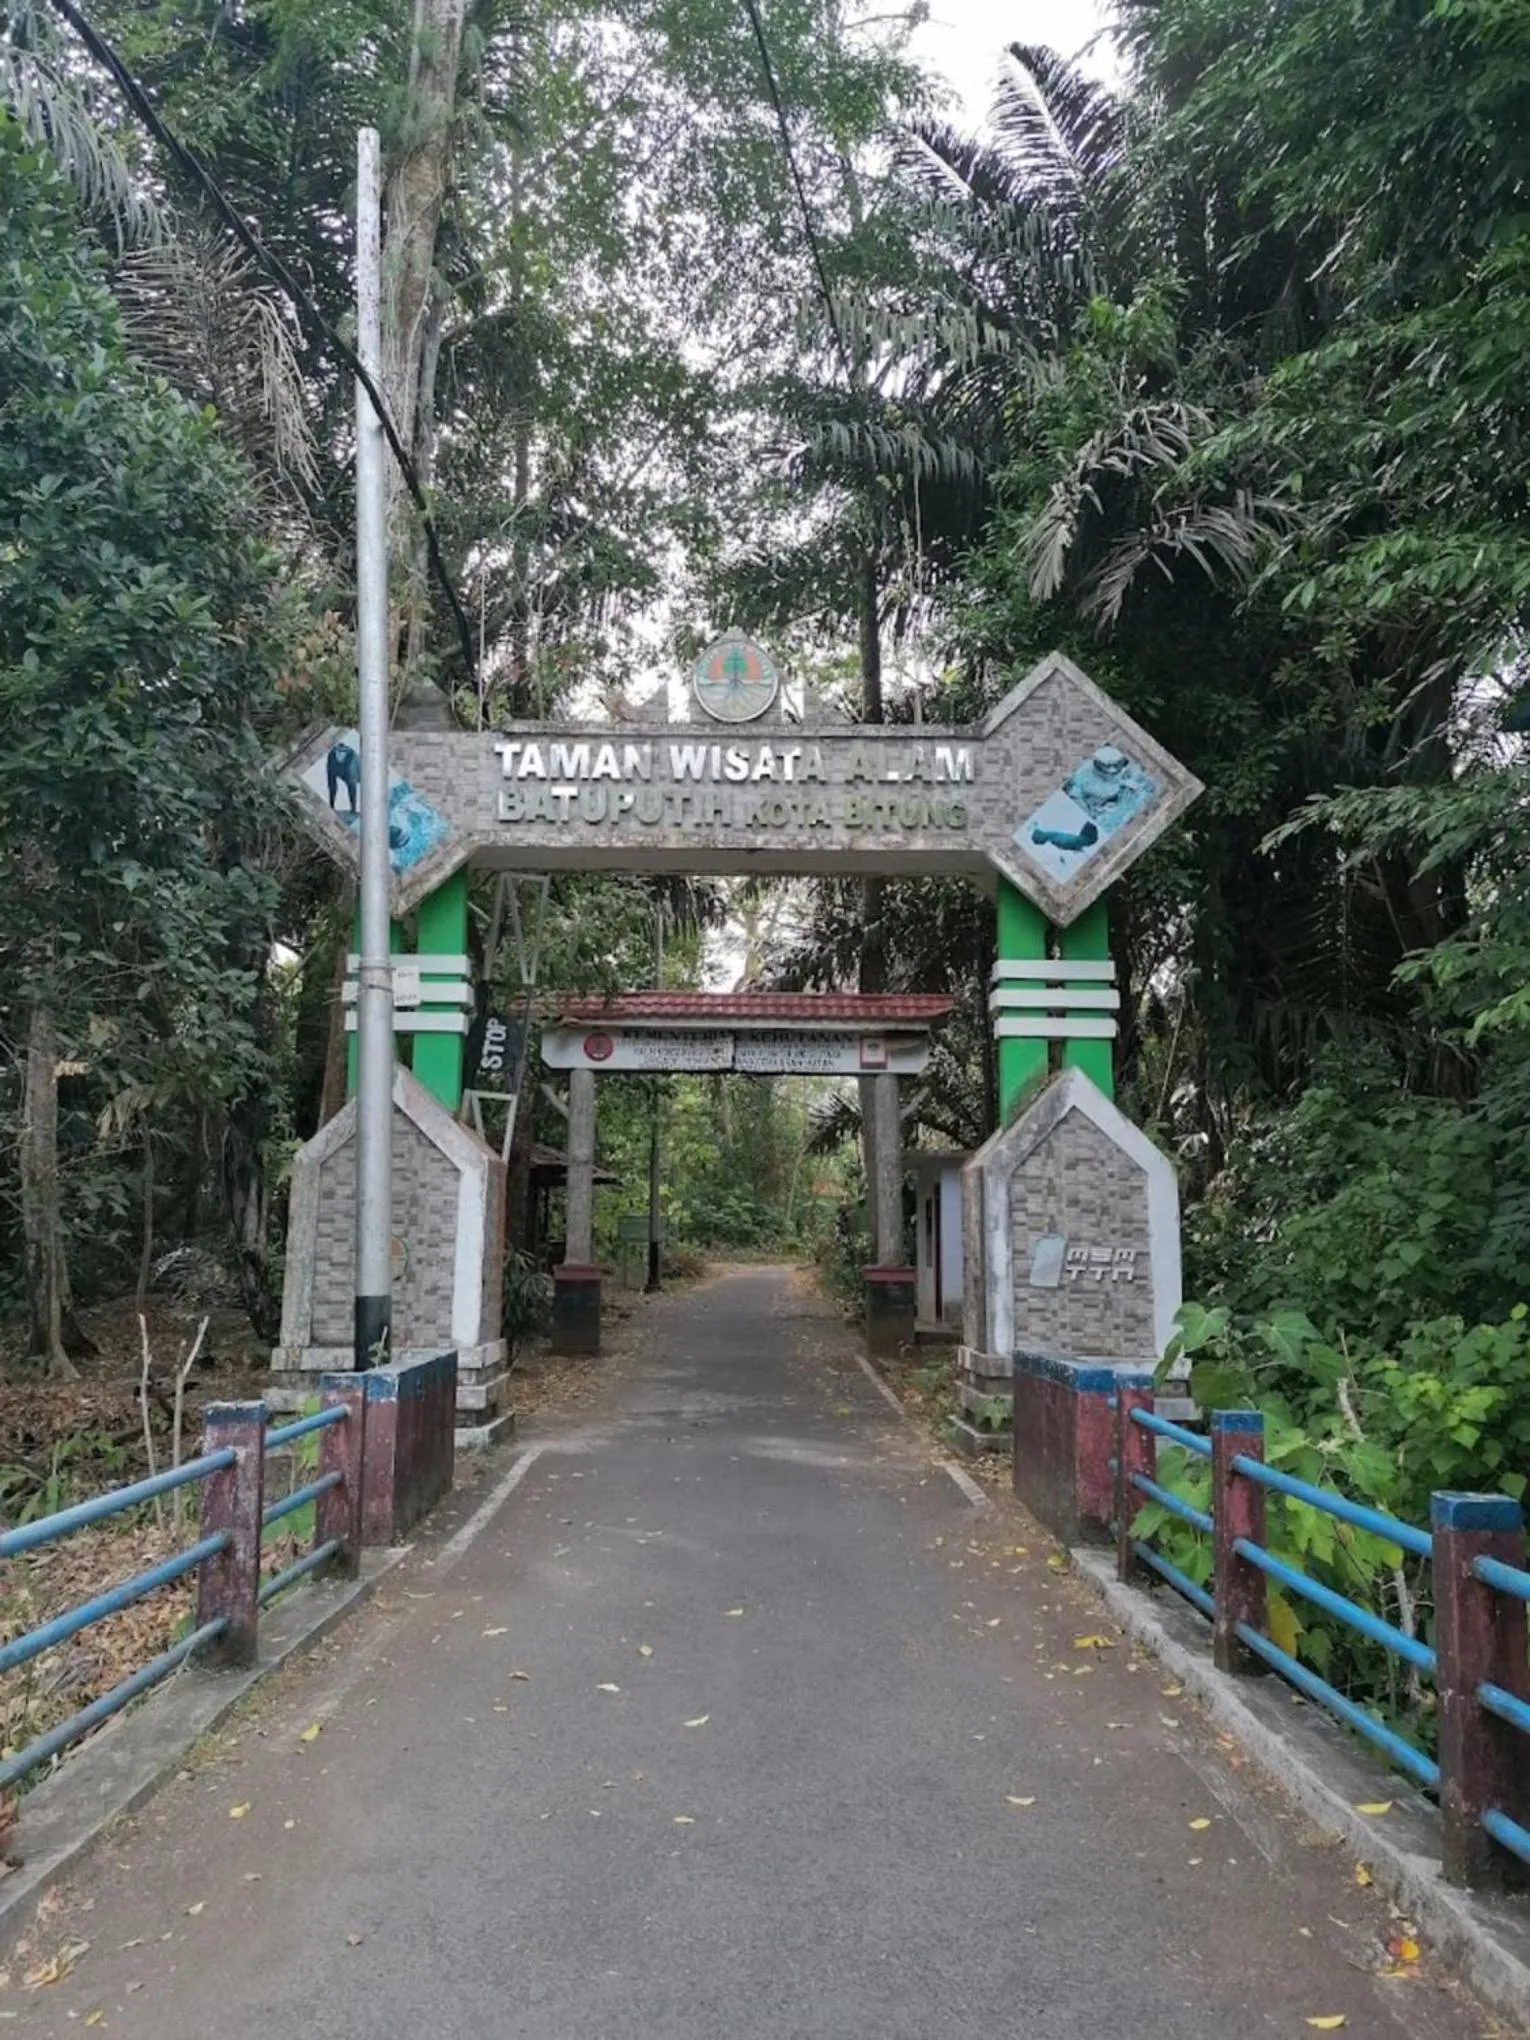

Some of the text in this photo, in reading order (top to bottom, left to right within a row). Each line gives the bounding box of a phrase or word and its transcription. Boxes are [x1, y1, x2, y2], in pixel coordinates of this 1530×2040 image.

[495, 743, 975, 784] TAMAN WISATA ALAM
[497, 785, 969, 830] BATUPUTIH KOTA BITUNG
[481, 1017, 507, 1069] STOP
